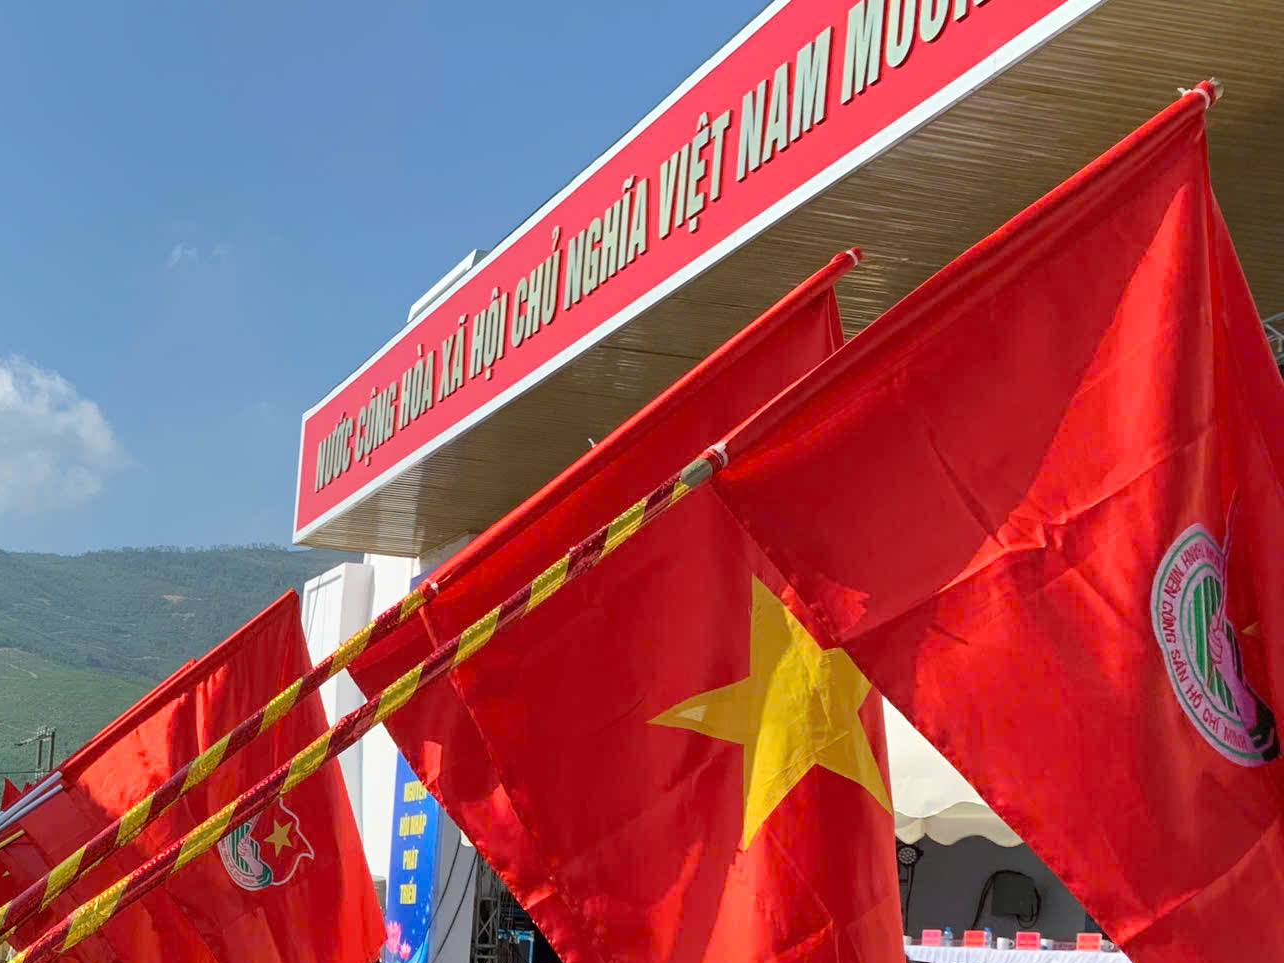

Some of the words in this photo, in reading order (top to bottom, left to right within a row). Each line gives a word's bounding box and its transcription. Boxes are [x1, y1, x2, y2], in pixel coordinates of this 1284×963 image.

[315, 411, 354, 493] NƯỚC
[354, 382, 398, 467] CỘNG
[398, 341, 435, 431] HÒA
[436, 313, 468, 402] XÃ
[468, 286, 509, 380] HỘI
[511, 225, 561, 349] CHỦ
[564, 174, 649, 311] NGHĨA
[659, 111, 733, 240] VIỆT
[735, 25, 835, 183] NAM
